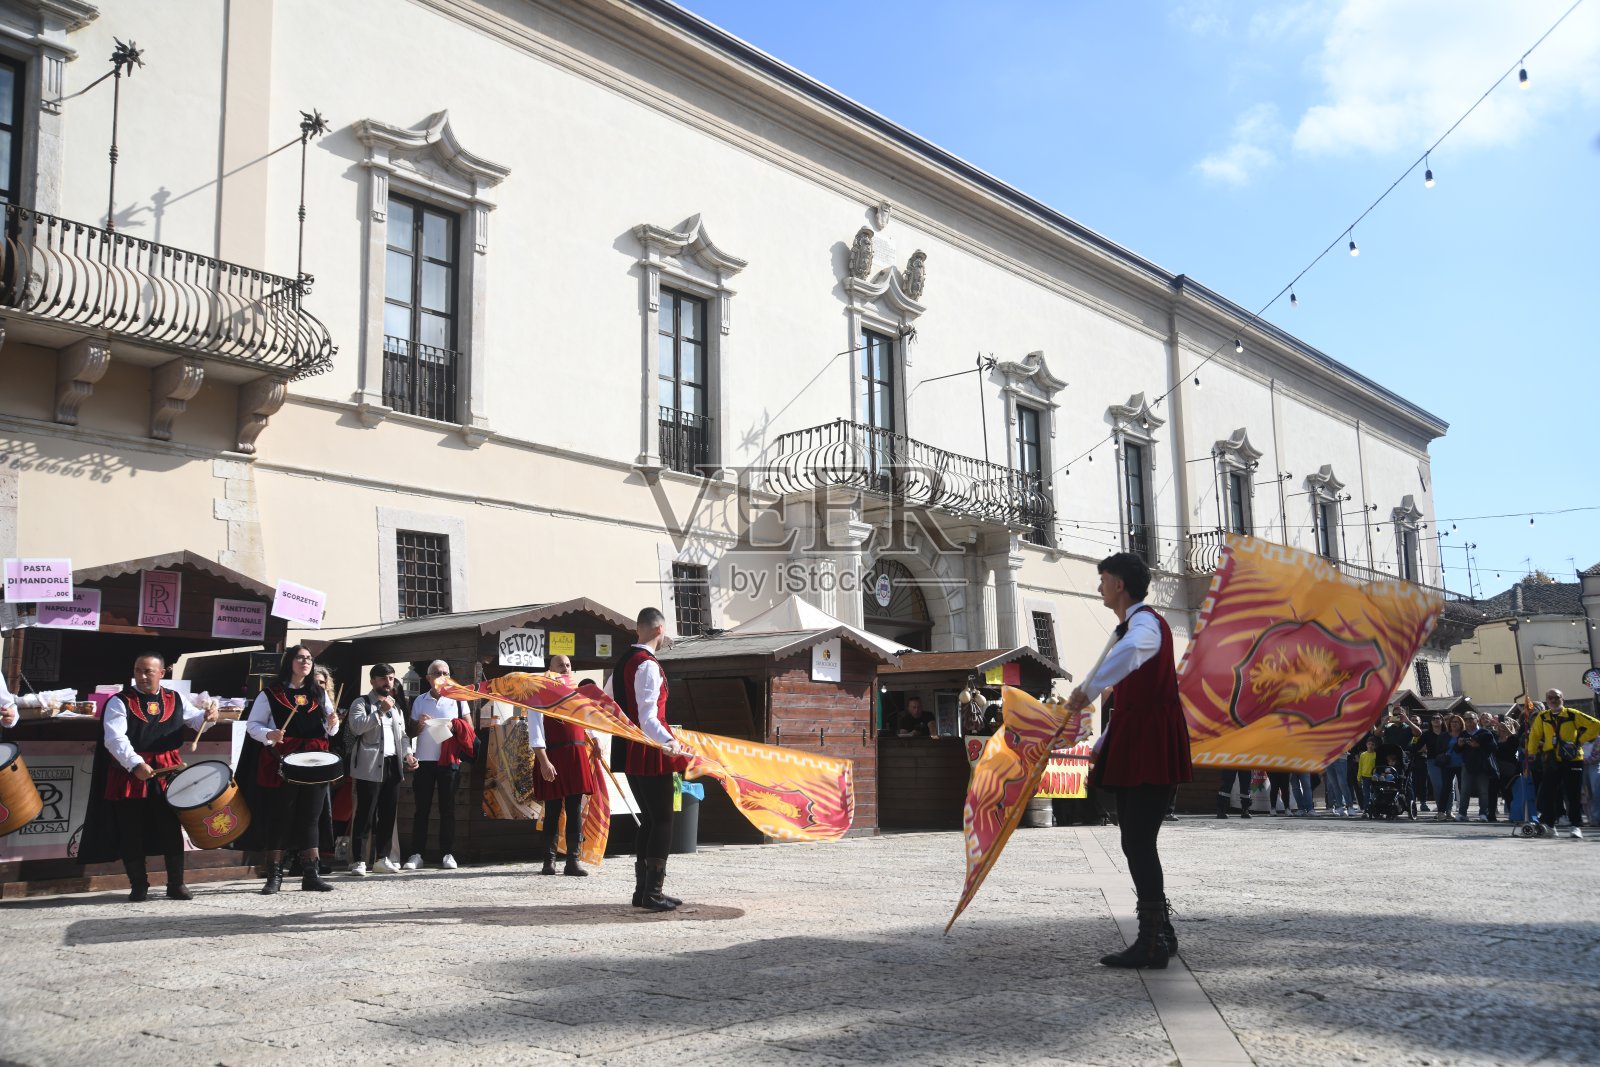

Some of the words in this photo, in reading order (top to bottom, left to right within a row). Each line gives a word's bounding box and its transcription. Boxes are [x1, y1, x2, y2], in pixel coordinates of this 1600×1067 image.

[282, 591, 319, 607] SCORZETTE
[45, 605, 92, 614] NAPOLETANO
[220, 604, 261, 613] PANETTONE
[217, 615, 262, 625] ARTIGIANALE
[1037, 771, 1081, 795] ANINI
[24, 822, 66, 834] ROSA
